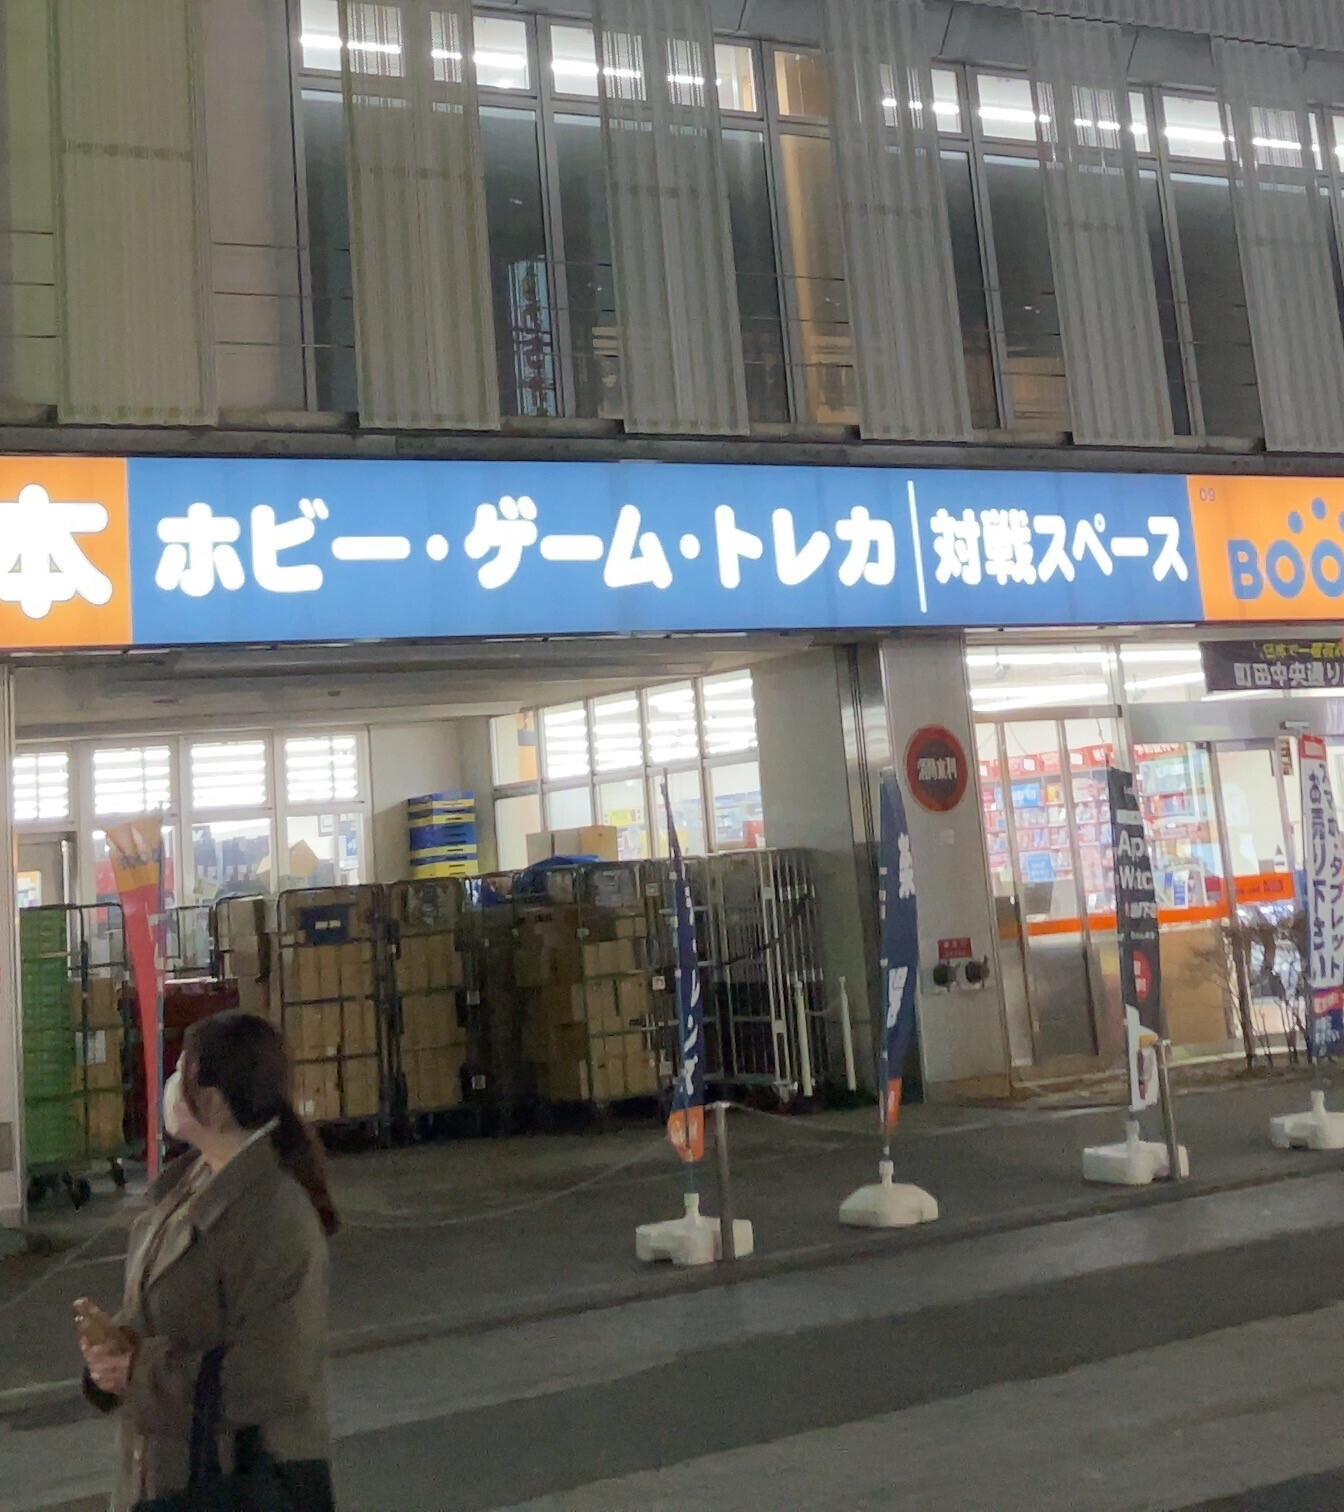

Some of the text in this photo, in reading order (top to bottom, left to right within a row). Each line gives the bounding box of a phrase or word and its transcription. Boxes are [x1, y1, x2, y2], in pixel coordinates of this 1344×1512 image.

[155, 496, 897, 597] ホビー・ゲーム・トレカ
[930, 506, 1190, 586] 対戦スペース
